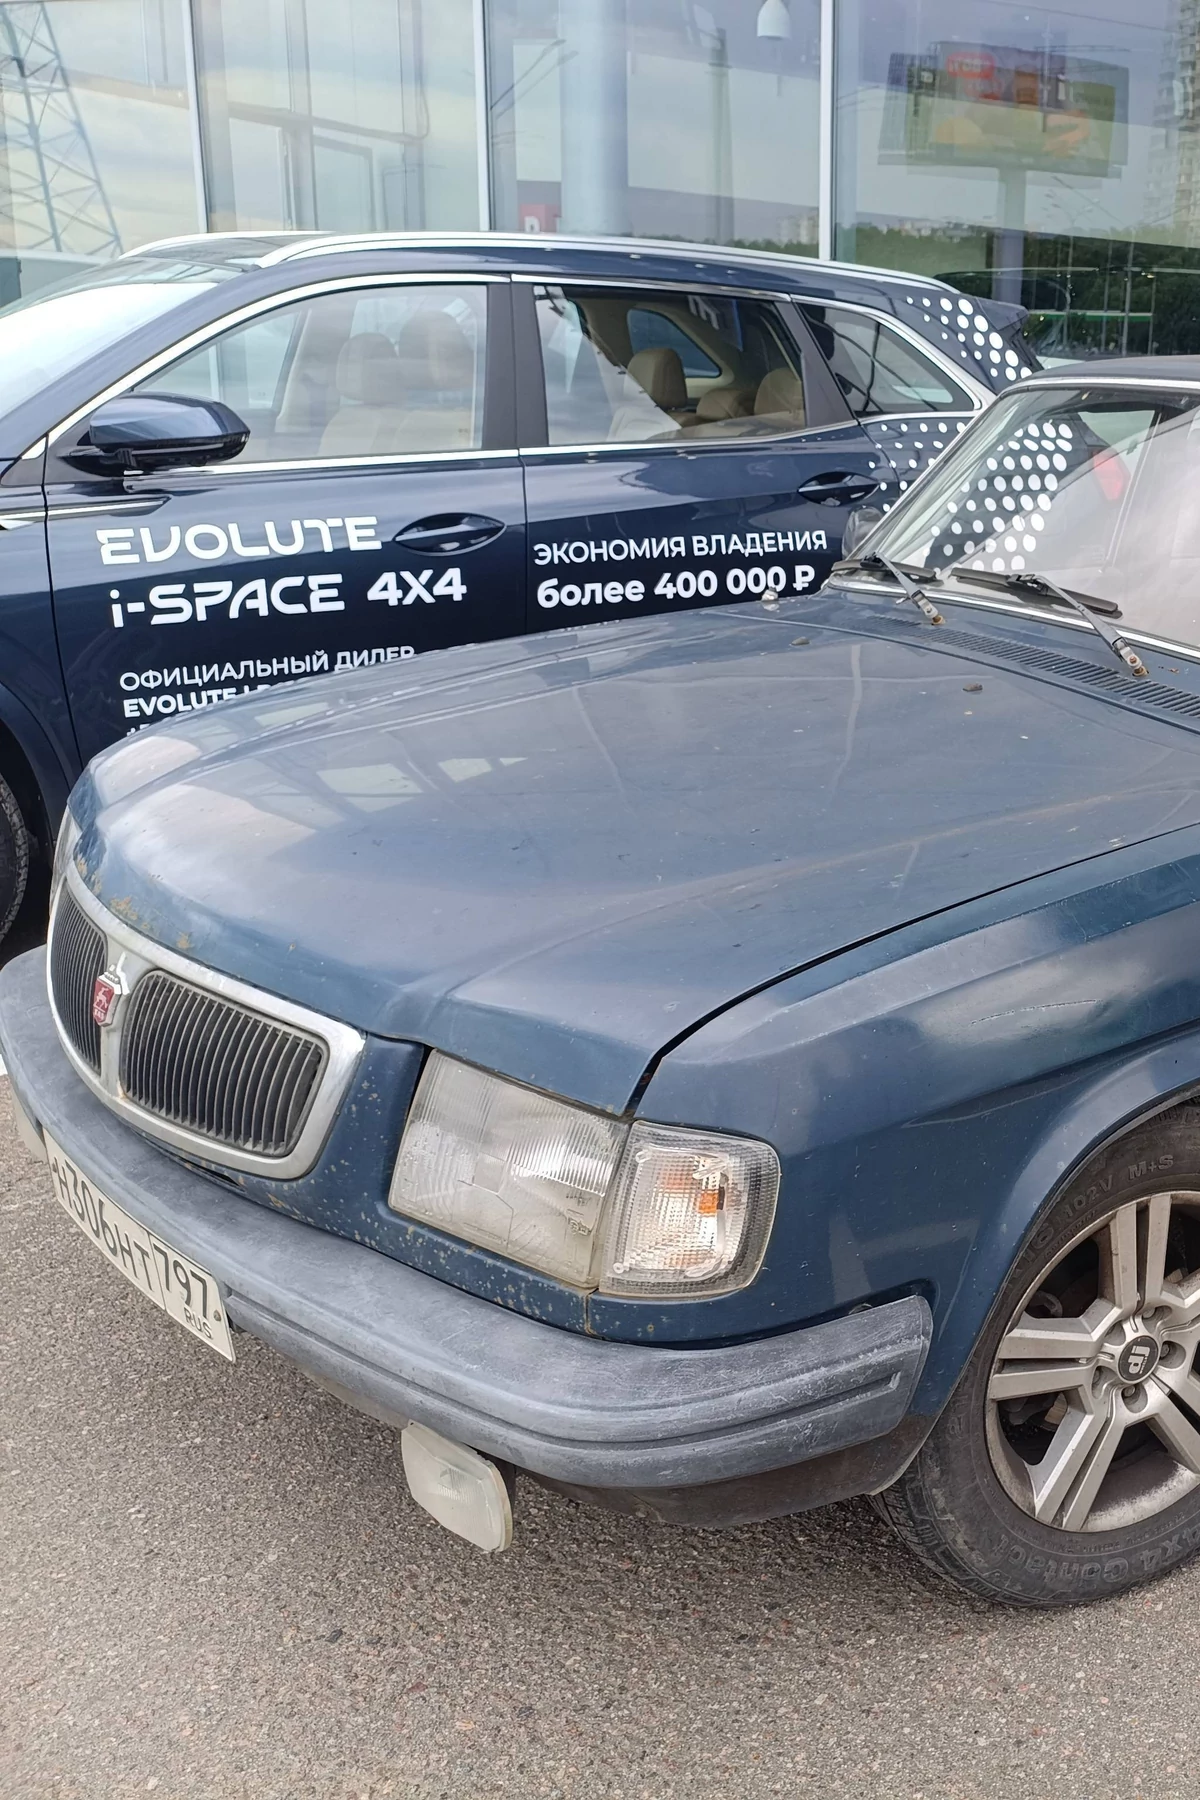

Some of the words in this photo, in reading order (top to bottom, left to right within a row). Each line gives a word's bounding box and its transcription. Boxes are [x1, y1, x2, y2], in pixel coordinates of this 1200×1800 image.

[96, 516, 382, 565] EVOLUTE
[533, 536, 686, 565] ЭКОНОМИЯ
[692, 530, 828, 557] ВЛАДЕНИЯ
[109, 573, 345, 628] i-SPACE
[537, 578, 645, 608] более
[654, 569, 718, 599] 400
[726, 566, 786, 596] 000
[119, 650, 329, 691] ОФИЦИАЛЬНЫЙ
[334, 645, 415, 673] ДИЛЕР
[1128, 1154, 1174, 1180] M+S
[153, 1243, 208, 1320] 797
[183, 1307, 213, 1340] RUS
